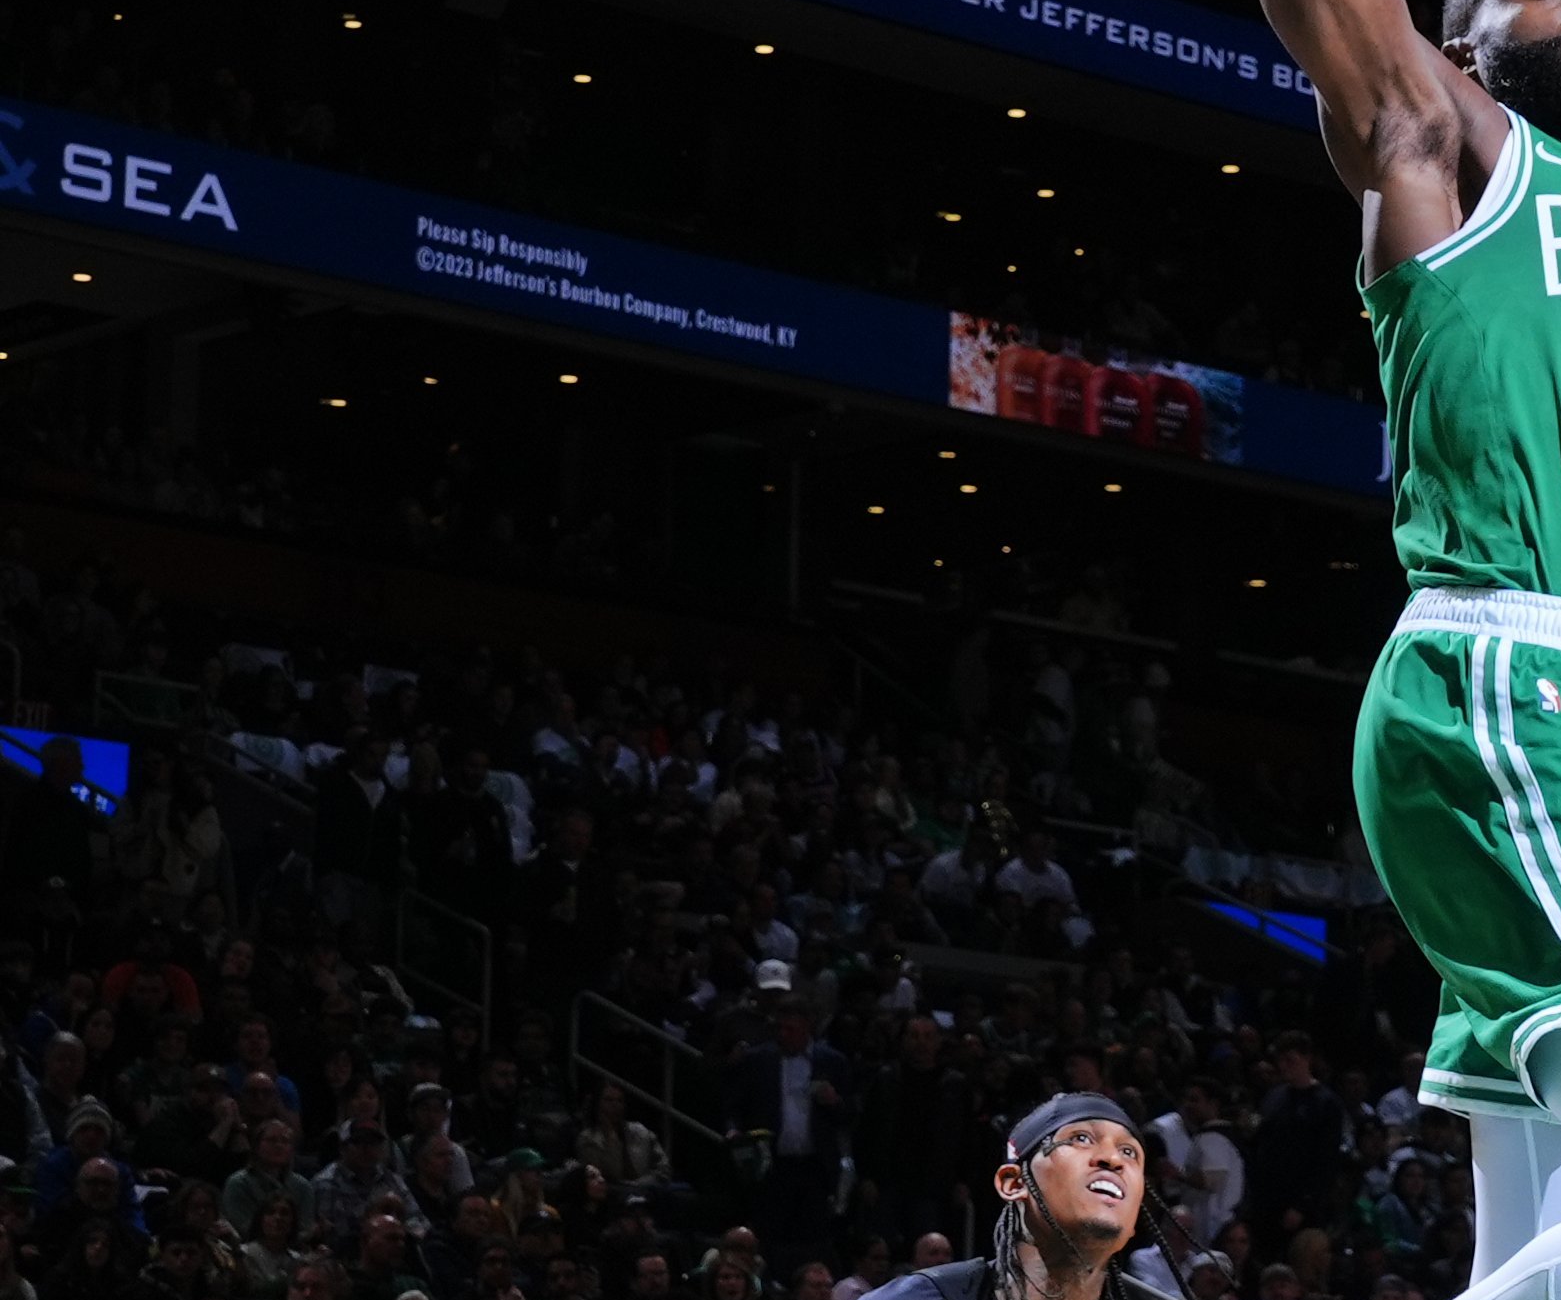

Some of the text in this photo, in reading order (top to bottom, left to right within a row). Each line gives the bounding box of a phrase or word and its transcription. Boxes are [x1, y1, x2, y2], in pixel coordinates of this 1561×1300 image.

[60, 143, 239, 232] SEA
[416, 216, 588, 277] Please Sip Responsibly
[416, 246, 473, 279] ©2023
[476, 260, 558, 297] Jefferson's
[560, 278, 621, 311] Bourbon
[623, 293, 692, 329] Company,
[776, 325, 798, 349] KY
